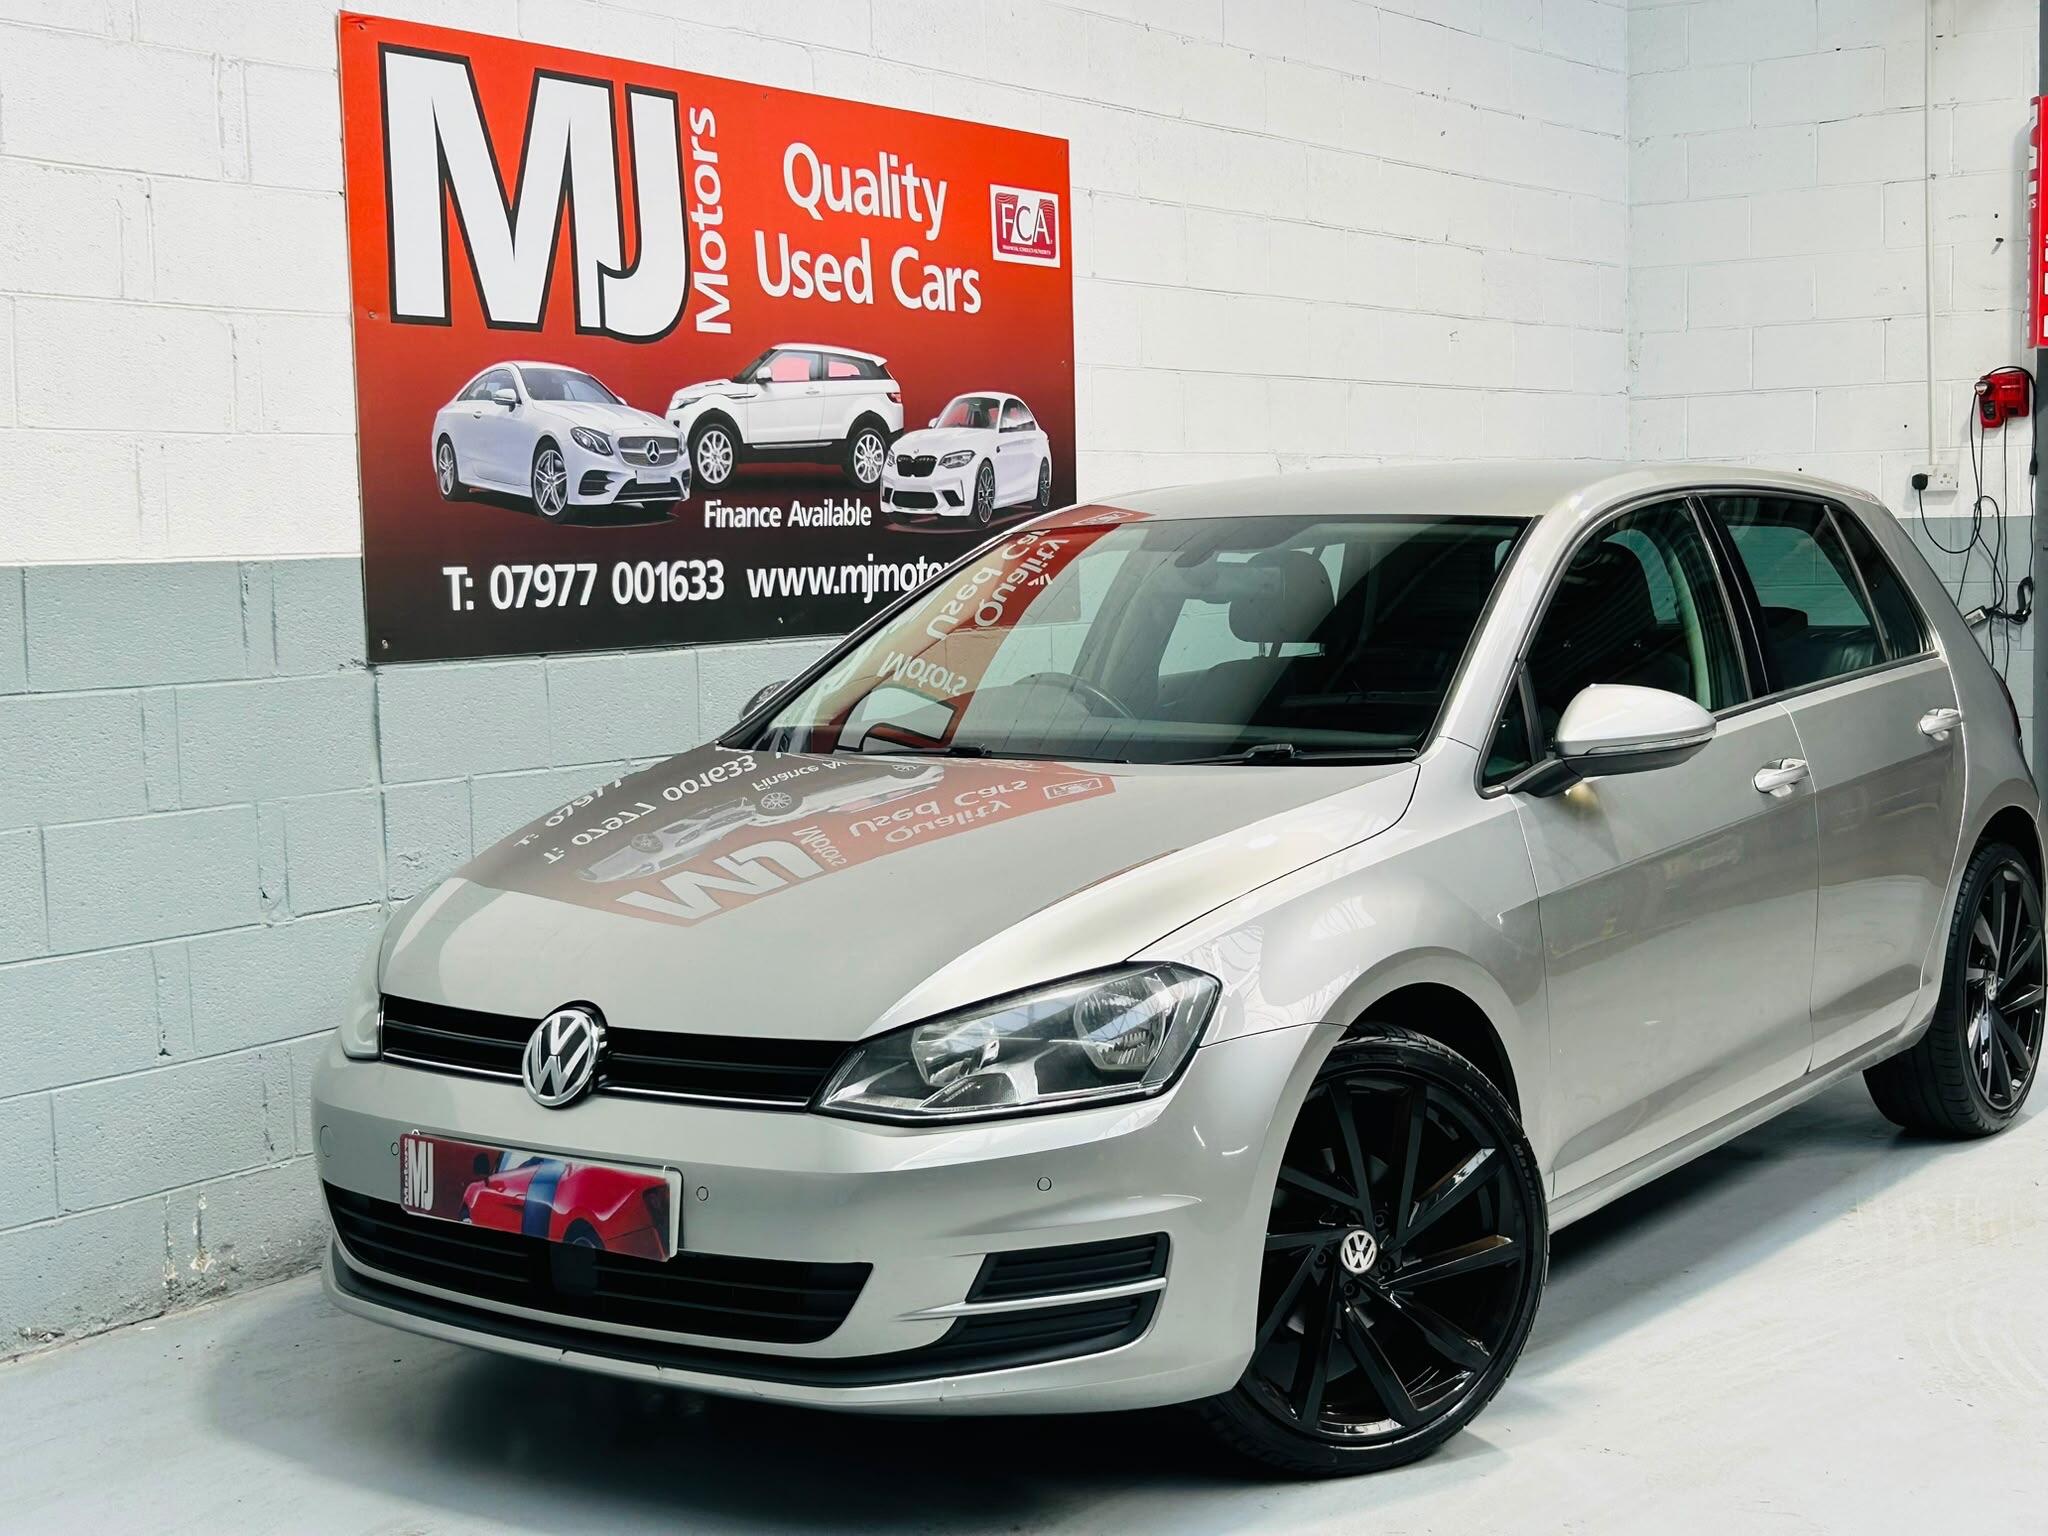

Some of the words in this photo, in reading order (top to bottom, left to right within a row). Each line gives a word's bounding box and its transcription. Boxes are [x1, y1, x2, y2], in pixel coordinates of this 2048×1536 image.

[379, 44, 689, 342] MJ
[689, 106, 732, 335] Motors
[783, 142, 948, 241] Quality
[1001, 203, 1052, 245] FCA
[754, 229, 874, 305] Used
[890, 246, 982, 314] Cars
[704, 499, 782, 528] Finance
[787, 498, 872, 527] Available
[442, 566, 475, 611] T:
[489, 563, 598, 610] 07977
[611, 558, 725, 605] 001633
[746, 553, 951, 604] www.mjmoto
[407, 1138, 434, 1211] MJ
[1341, 1230, 1377, 1273] VW
